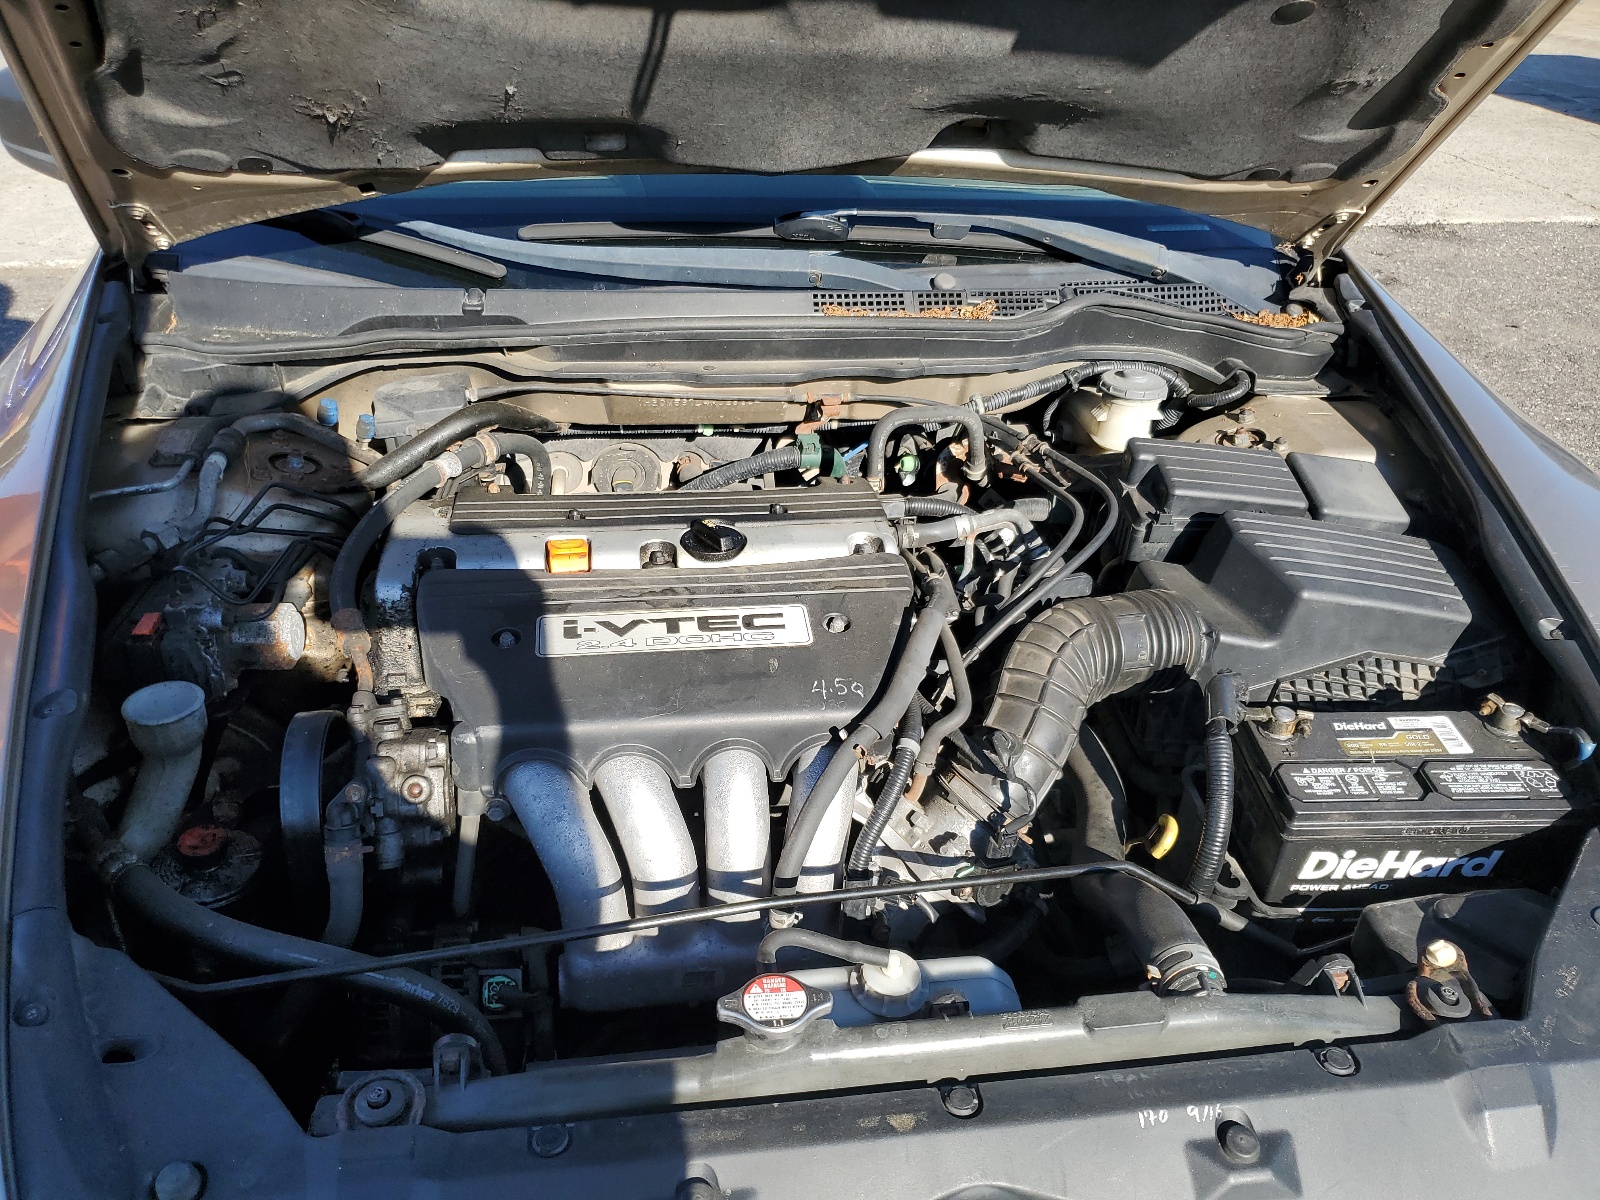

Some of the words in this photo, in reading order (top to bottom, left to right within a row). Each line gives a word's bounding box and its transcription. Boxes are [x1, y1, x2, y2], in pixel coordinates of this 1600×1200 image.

[563, 612, 785, 639] i-VTEC
[576, 637, 638, 651] 2.4
[645, 631, 775, 647] DOHC
[1332, 722, 1387, 731] DieHard
[1297, 849, 1505, 880] DieHard
[1289, 884, 1340, 892] POWER
[1341, 883, 1390, 891] AHEAD
